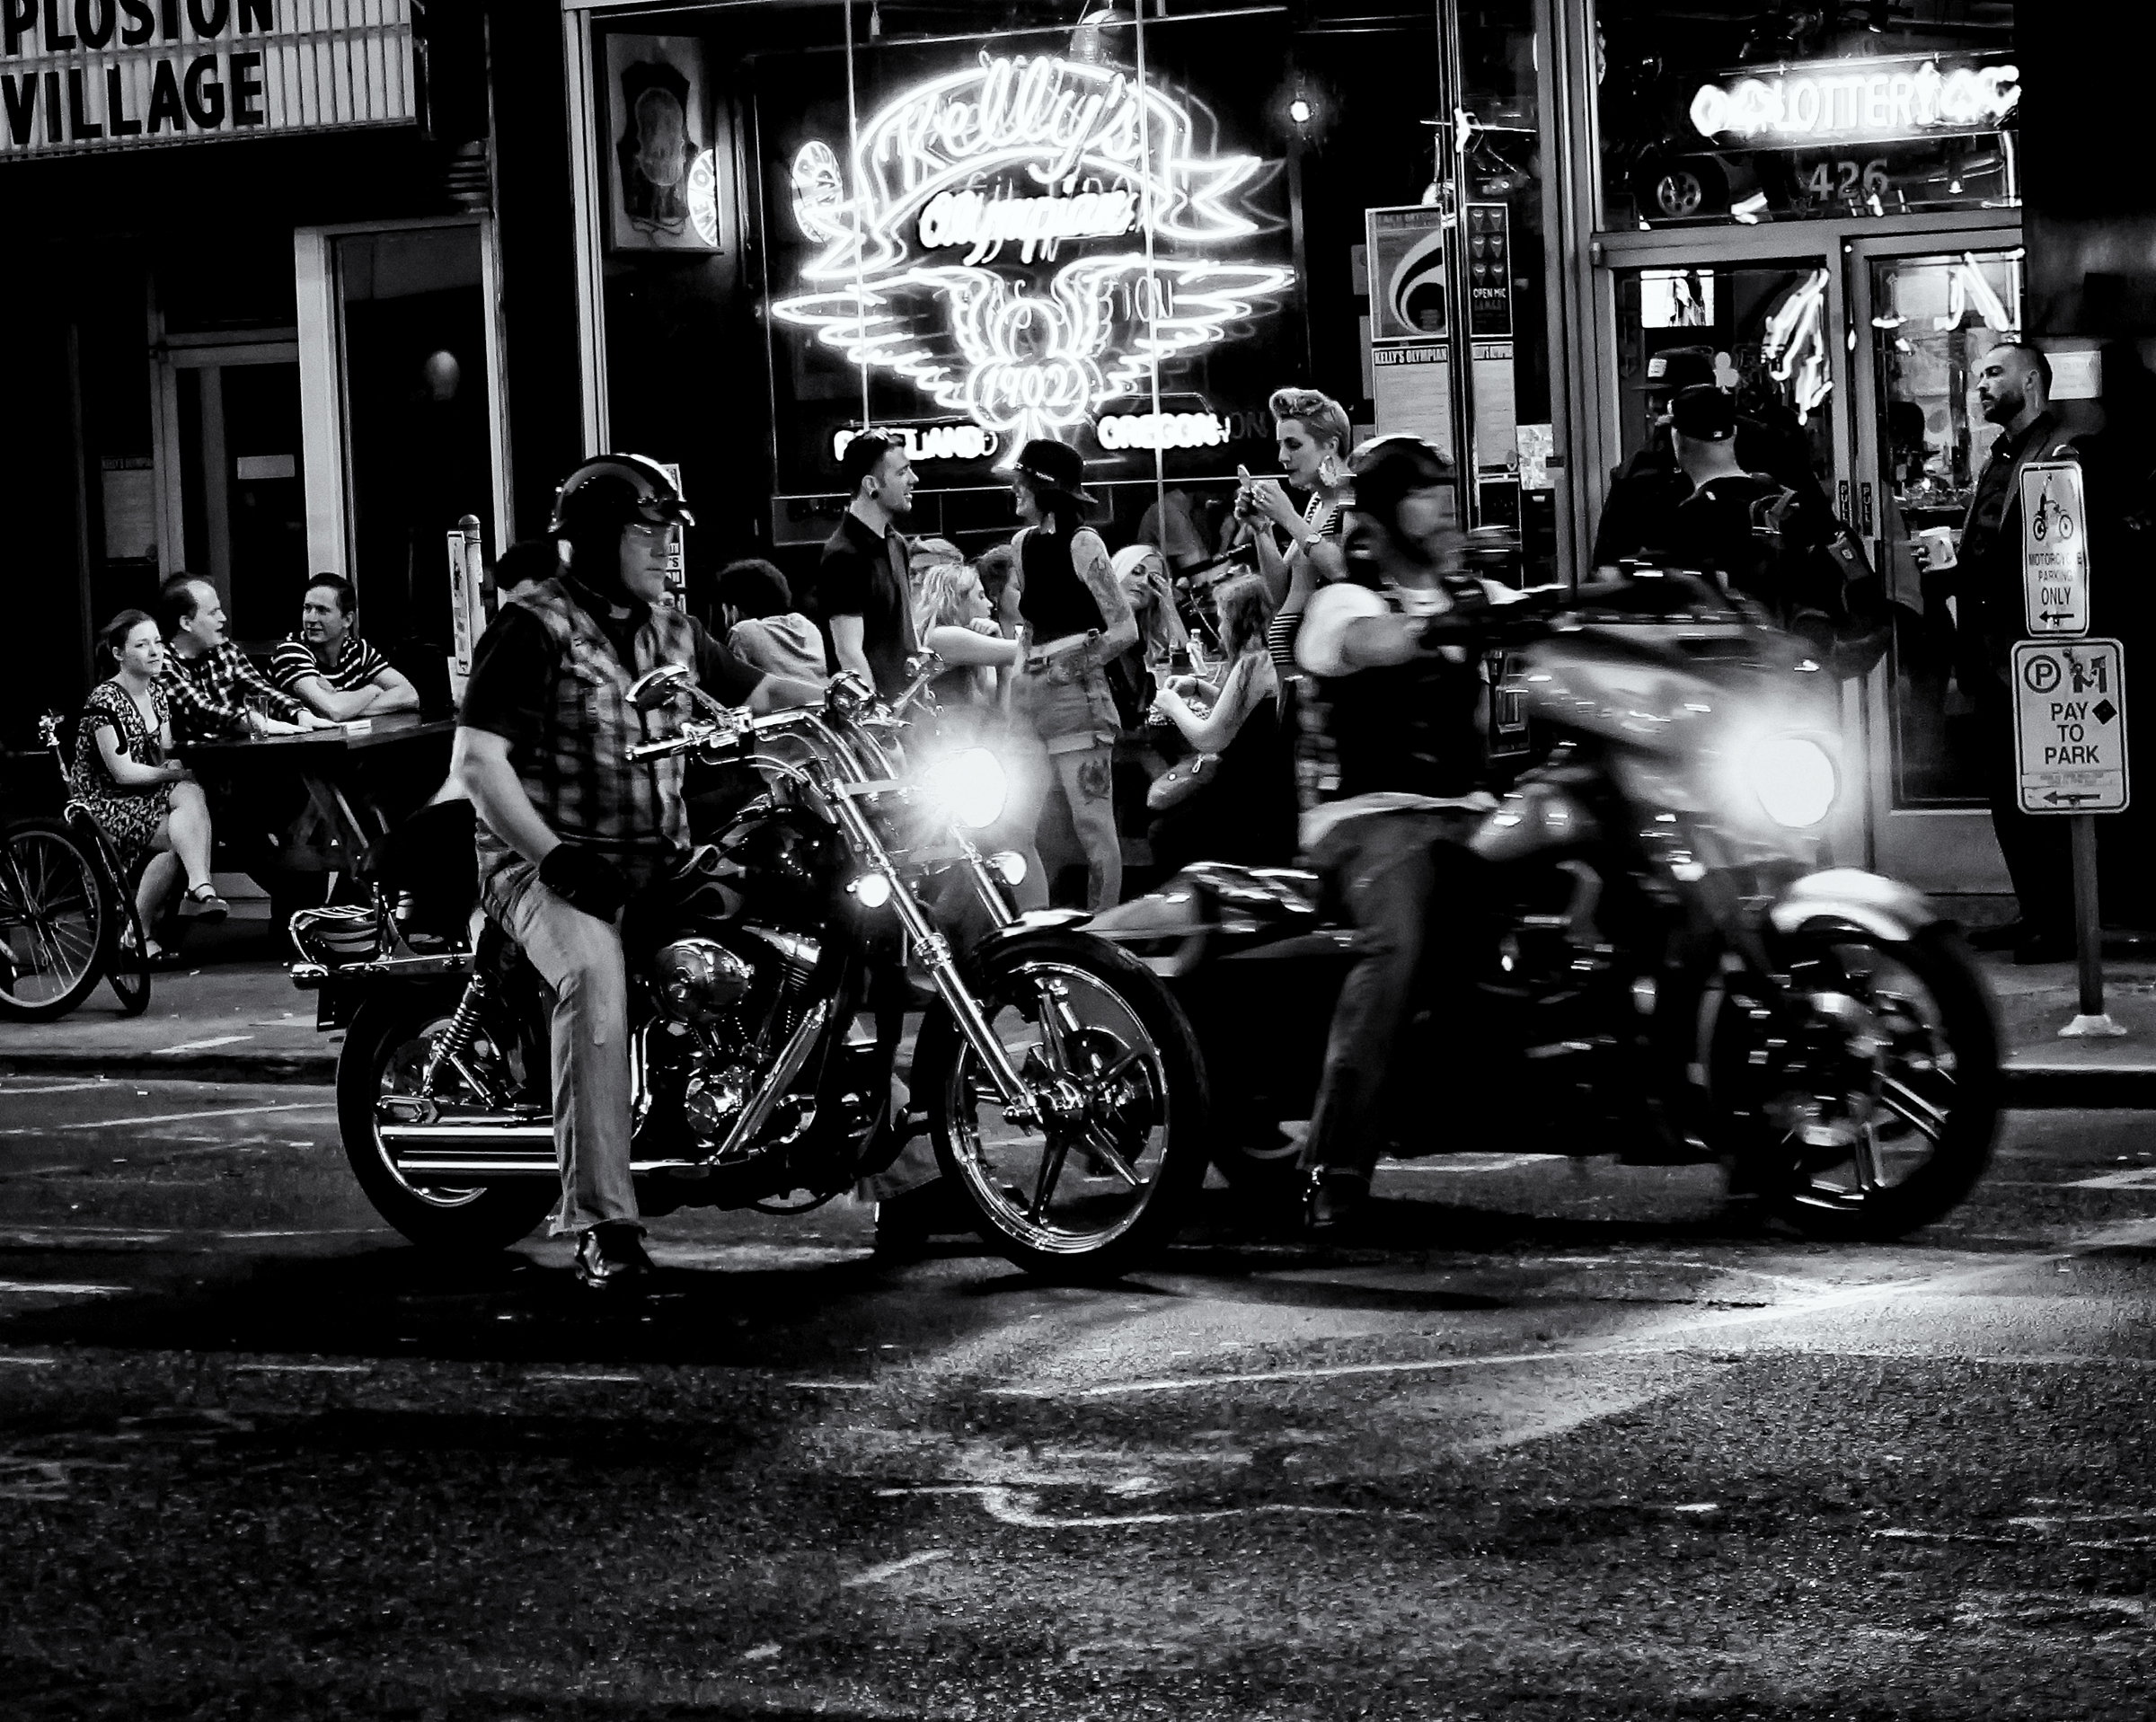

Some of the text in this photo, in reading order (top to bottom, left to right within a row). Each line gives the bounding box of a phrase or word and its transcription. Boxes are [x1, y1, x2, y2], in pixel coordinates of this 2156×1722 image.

[0, 51, 264, 145] VILLAGE
[1772, 72, 1937, 132] LOTTERY
[878, 57, 1144, 190] Kelly's
[1808, 159, 1889, 200] 426
[1473, 287, 1507, 298] OPEN MIC
[1375, 348, 1446, 365] KELLY'S OLYMPIAN
[982, 363, 1072, 408] 1902
[1097, 412, 1227, 450] OREGON
[1841, 484, 1849, 521] PULL
[1863, 486, 1871, 523] PULL
[2041, 587, 2072, 605] ONLY
[2051, 702, 2089, 721] PAY
[2057, 723, 2084, 743] TO
[2045, 745, 2100, 764] PARK
